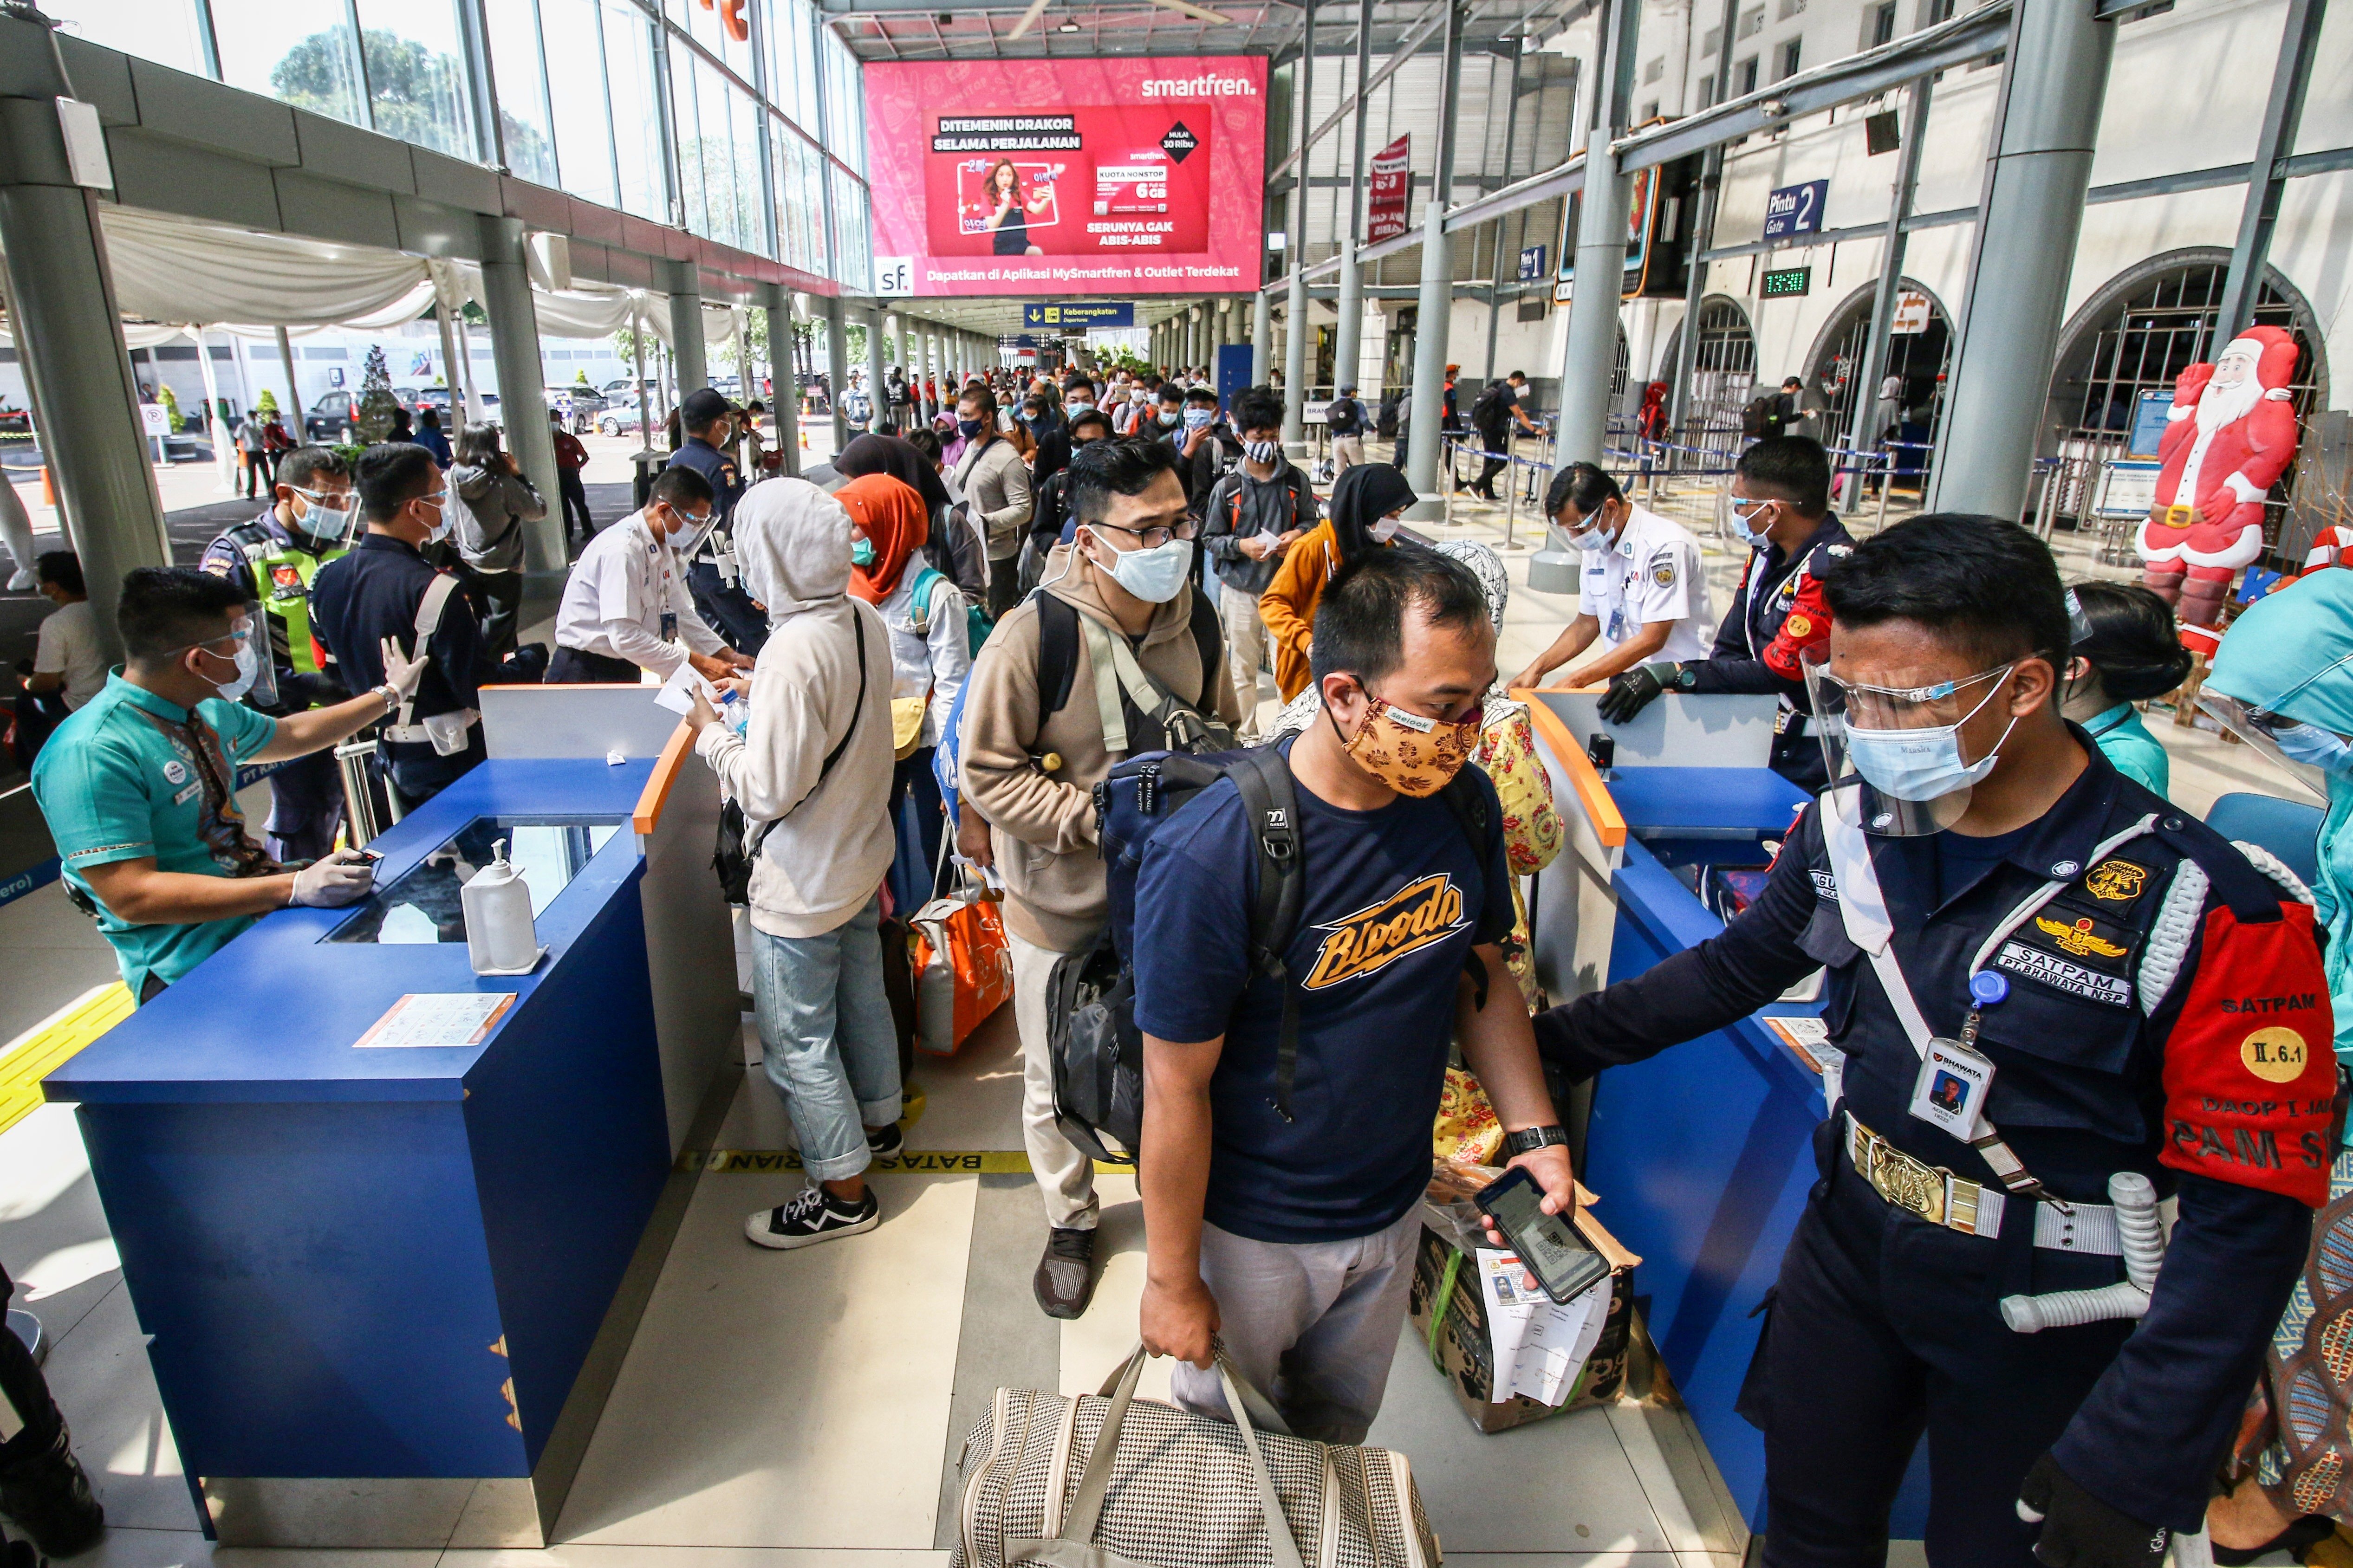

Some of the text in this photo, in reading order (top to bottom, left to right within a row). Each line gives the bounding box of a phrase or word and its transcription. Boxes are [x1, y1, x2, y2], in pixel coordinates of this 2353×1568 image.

[1142, 73, 1256, 97] smartfren.
[940, 118, 1073, 132] DITEMENIN DRAKOR
[934, 136, 1080, 150] SELAMA PERJALANAN
[1175, 140, 1193, 148] Ribu
[1136, 182, 1166, 199] 6 GB
[1769, 186, 1814, 231] Pintu 2
[1087, 222, 1173, 233] SERUNYA GAK
[1766, 220, 1785, 234] Gate
[1099, 235, 1161, 246] ABIS-ABIS
[1532, 249, 1539, 278] 1
[927, 266, 1239, 283] Dapatkan di Aplikasi MySmartfren & Outlet Terdekat
[1063, 308, 1117, 317] Keberangkatan
[1391, 713, 1429, 729] saelook
[242, 768, 257, 784] PT
[2020, 949, 2114, 990] SATPAM
[2091, 990, 2123, 1002] NSP
[2221, 993, 2316, 1013] SATPAM
[1944, 1057, 1982, 1079] BHAWATA
[2202, 1097, 2277, 1116] DAOP
[2287, 1100, 2299, 1117] I
[2171, 1118, 2282, 1170] PAM
[731, 1154, 982, 1170] BATAS RIAN
